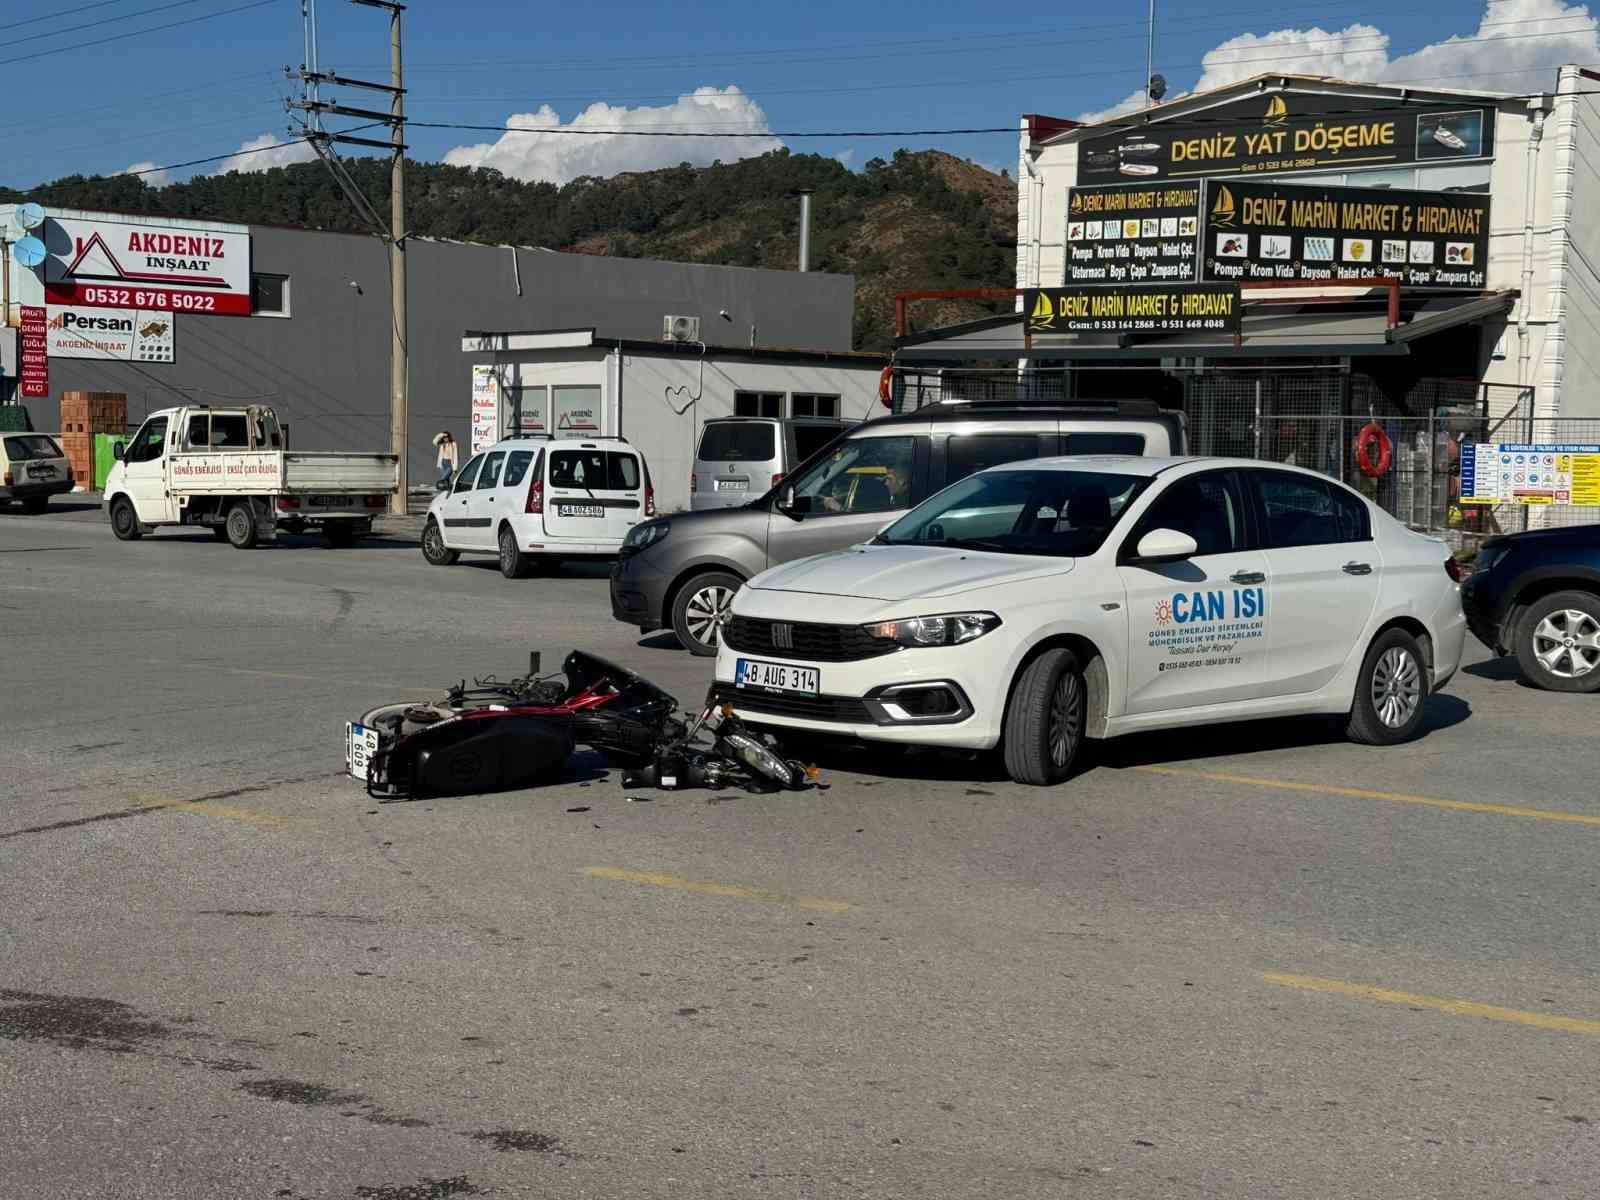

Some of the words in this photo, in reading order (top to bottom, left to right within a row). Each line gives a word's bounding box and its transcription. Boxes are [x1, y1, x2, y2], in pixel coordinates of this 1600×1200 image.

[1171, 132, 1236, 162] DENİZ
[1244, 131, 1287, 156] YAT
[1294, 122, 1395, 154] DÖŞEME
[1083, 191, 1103, 212] DENİZ
[1104, 189, 1126, 210] MARİN
[1127, 191, 1155, 209] MARKET
[1156, 191, 1162, 207] &
[1163, 188, 1198, 208] HIRDAVAT
[1242, 191, 1287, 226] DENİZ
[1291, 194, 1337, 229] MARİN
[1341, 202, 1399, 232] MARKET
[1401, 205, 1413, 232] &
[1416, 206, 1483, 235] HIRDAVAT
[127, 232, 225, 258] AKDENİZ
[1072, 246, 1093, 262] Pompa
[1097, 246, 1115, 258] Krom
[1115, 244, 1130, 258] Vida
[1134, 243, 1158, 260] Dayson
[1162, 241, 1180, 256] Halat
[146, 253, 210, 271] İNŞAAT
[1110, 264, 1126, 280] Boya
[1130, 264, 1147, 280] Çapa
[1151, 263, 1178, 279] Zımpara
[1214, 262, 1243, 278] Pompa
[1250, 264, 1273, 277] Krom
[1275, 265, 1294, 278] Vida
[1301, 265, 1331, 280] Dayson
[1337, 266, 1359, 279] Halat
[1409, 268, 1430, 284] Çapa
[1435, 269, 1467, 285] Zımpara
[85, 288, 130, 305] 0532
[135, 291, 167, 307] 676
[172, 294, 215, 310] 5022
[1059, 291, 1088, 317] DENİZ
[1091, 291, 1124, 317] MARİN
[1126, 295, 1168, 317] MARKET
[1170, 295, 1179, 316] &
[1181, 293, 1234, 316] HIRDAVAT
[63, 311, 133, 331] Persan
[1068, 320, 1093, 330] Gsm:
[1094, 320, 1100, 329] 0
[1101, 320, 1116, 330] 533
[1118, 320, 1133, 329] 164
[1134, 320, 1155, 329] 2868
[1161, 319, 1168, 328] 0
[1169, 319, 1185, 329] 531
[56, 339, 94, 349] AKDENİZ
[95, 340, 128, 352] İNŞAAT
[26, 384, 44, 393] ALÇI
[1172, 591, 1224, 623] CAN
[1233, 588, 1264, 618] ISI
[1205, 634, 1215, 642] VE
[1217, 630, 1263, 641] PAZARLAMA
[744, 663, 759, 682] 48
[763, 666, 787, 687] AUG
[791, 670, 815, 690] 314
[366, 732, 376, 749] 48
[354, 743, 364, 767] 609
